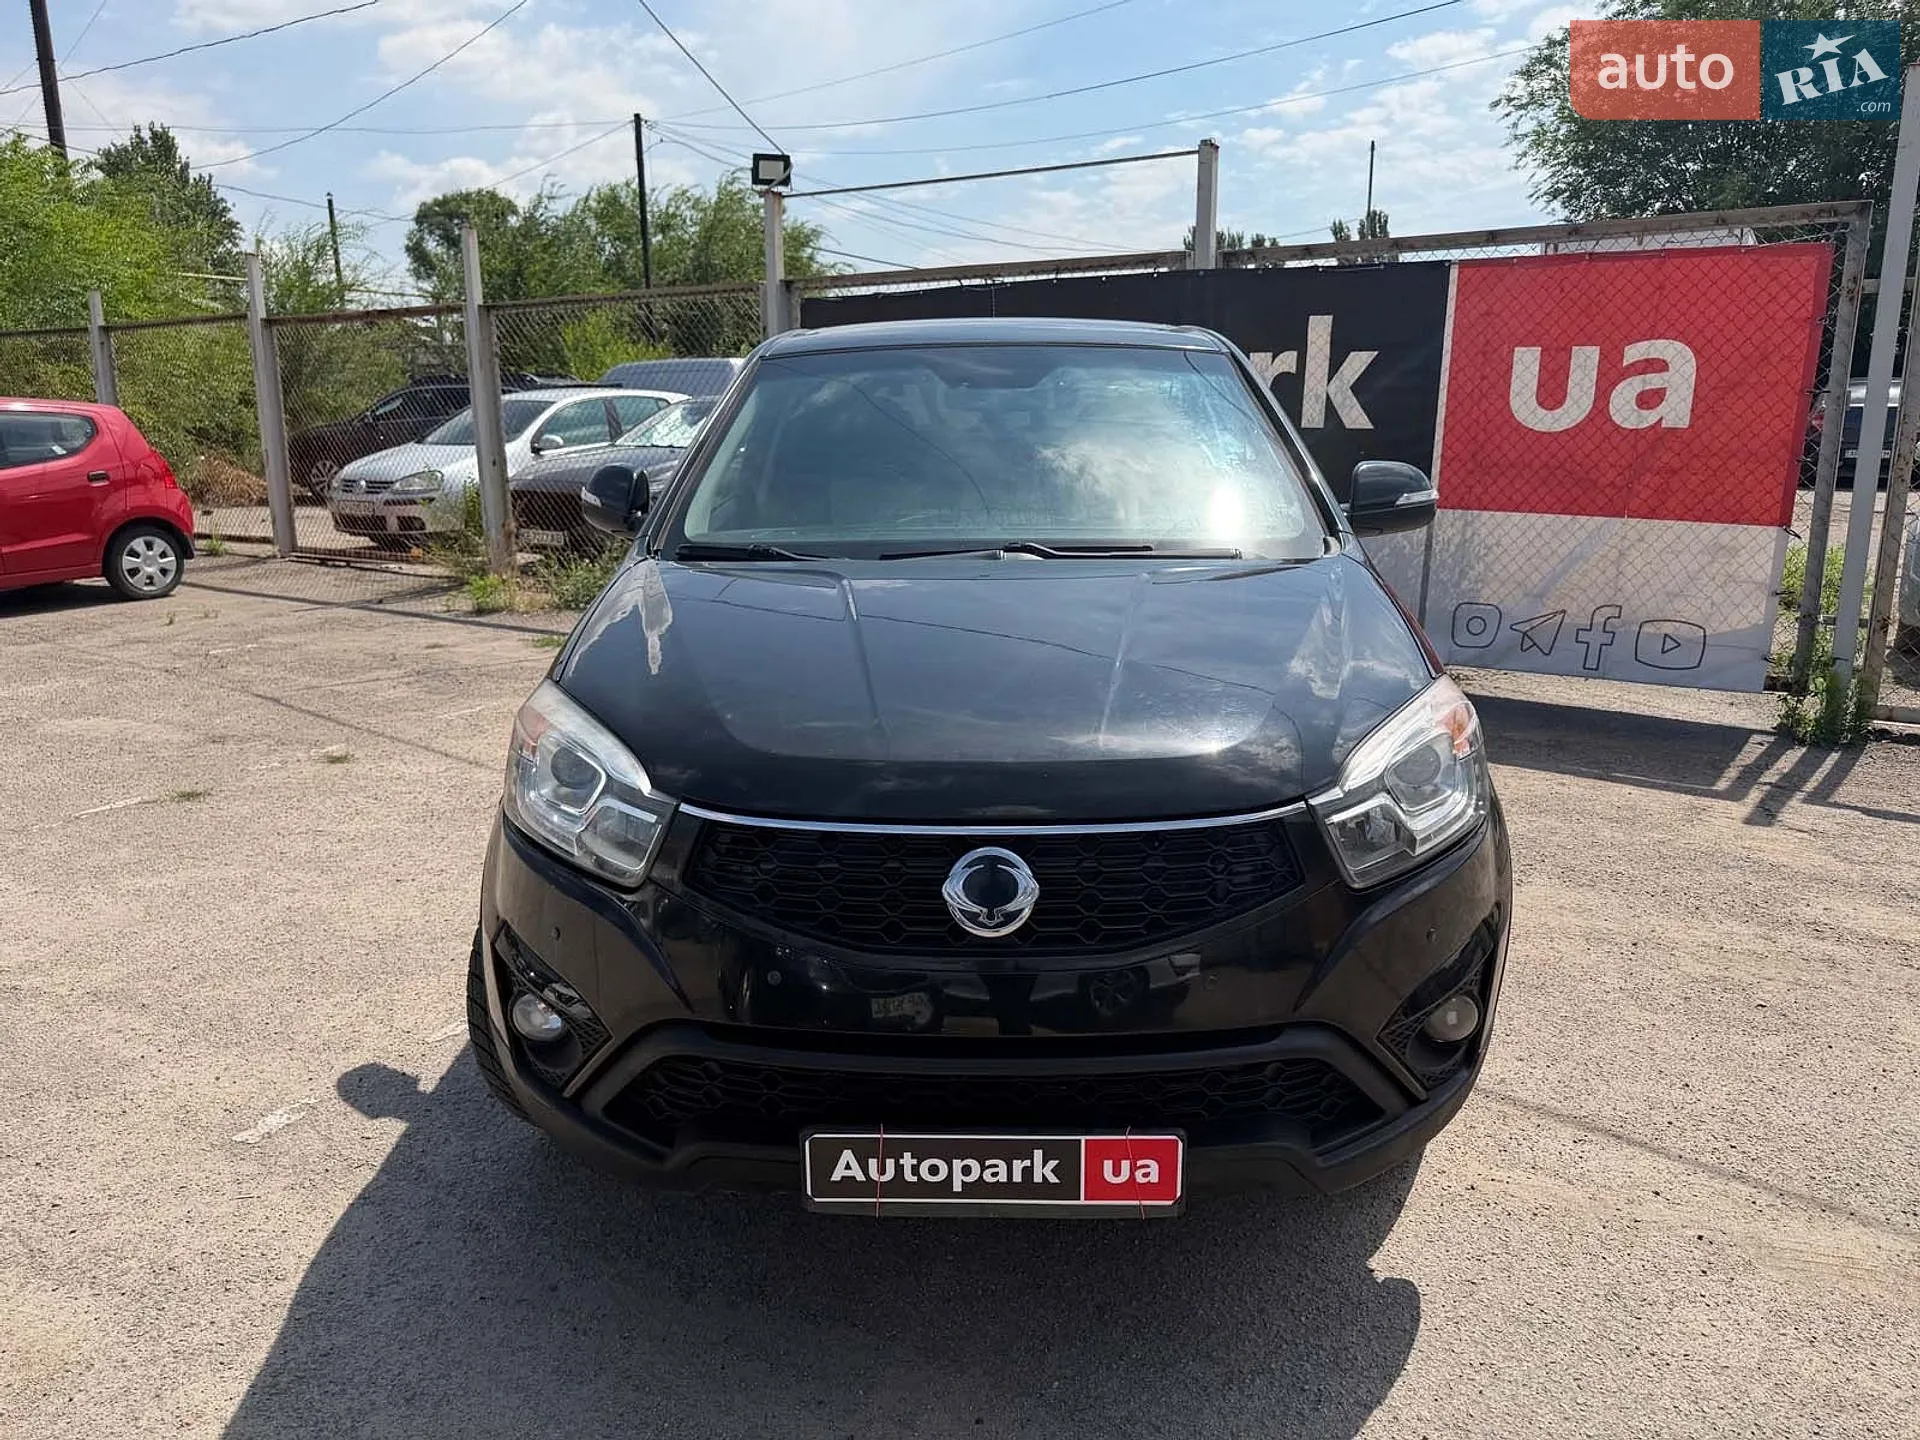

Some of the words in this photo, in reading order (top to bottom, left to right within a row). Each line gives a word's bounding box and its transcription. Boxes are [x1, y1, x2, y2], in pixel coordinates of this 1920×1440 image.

[1509, 338, 1698, 433] ua
[830, 1149, 1062, 1192] Autopark
[1103, 1158, 1160, 1185] ua
